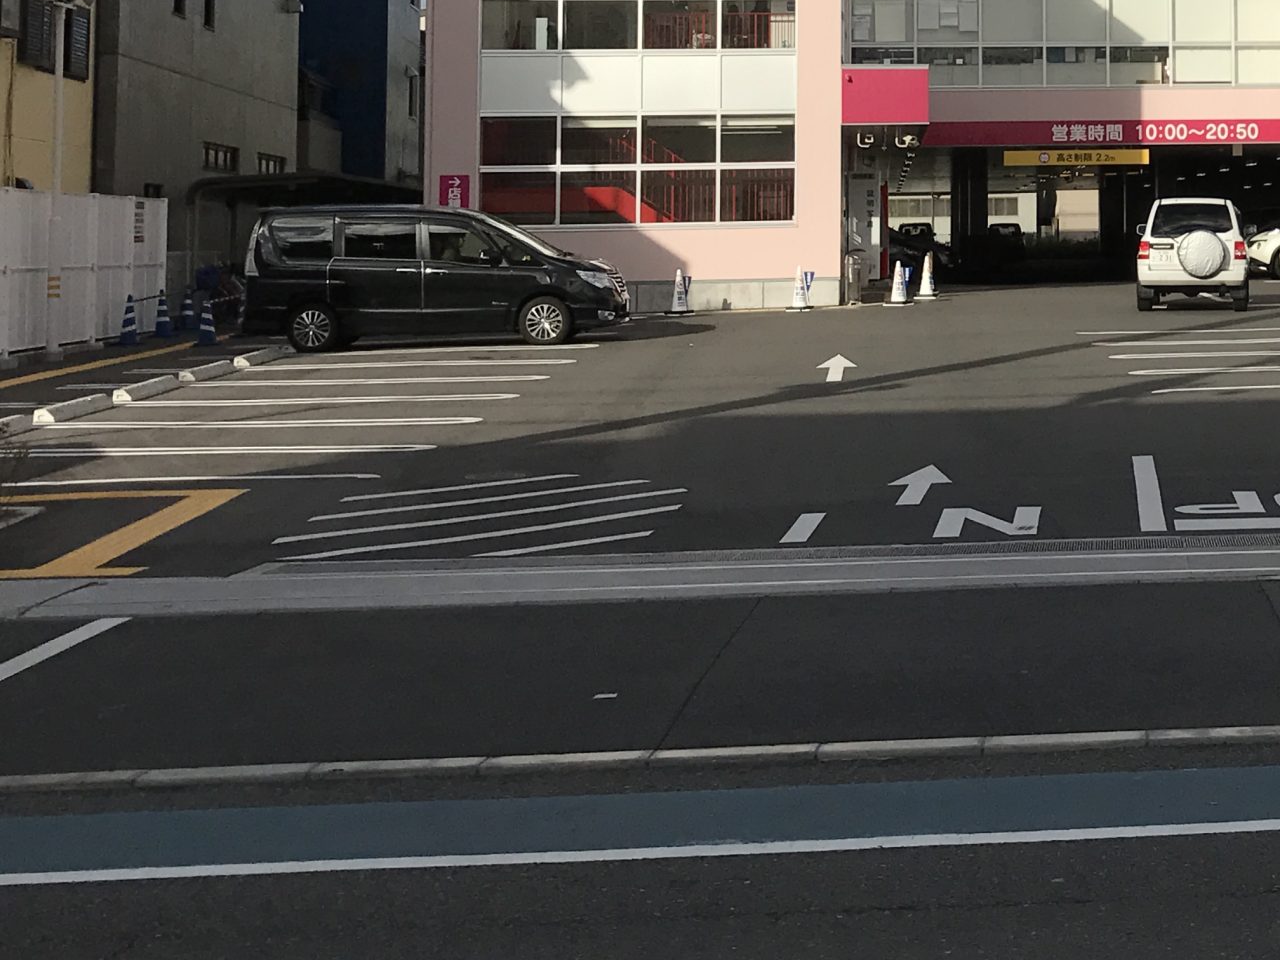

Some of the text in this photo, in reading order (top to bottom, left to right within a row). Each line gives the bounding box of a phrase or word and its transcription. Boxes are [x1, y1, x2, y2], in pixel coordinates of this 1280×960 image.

[1051, 123, 1123, 142] 営業時間
[778, 505, 1043, 544] IN
